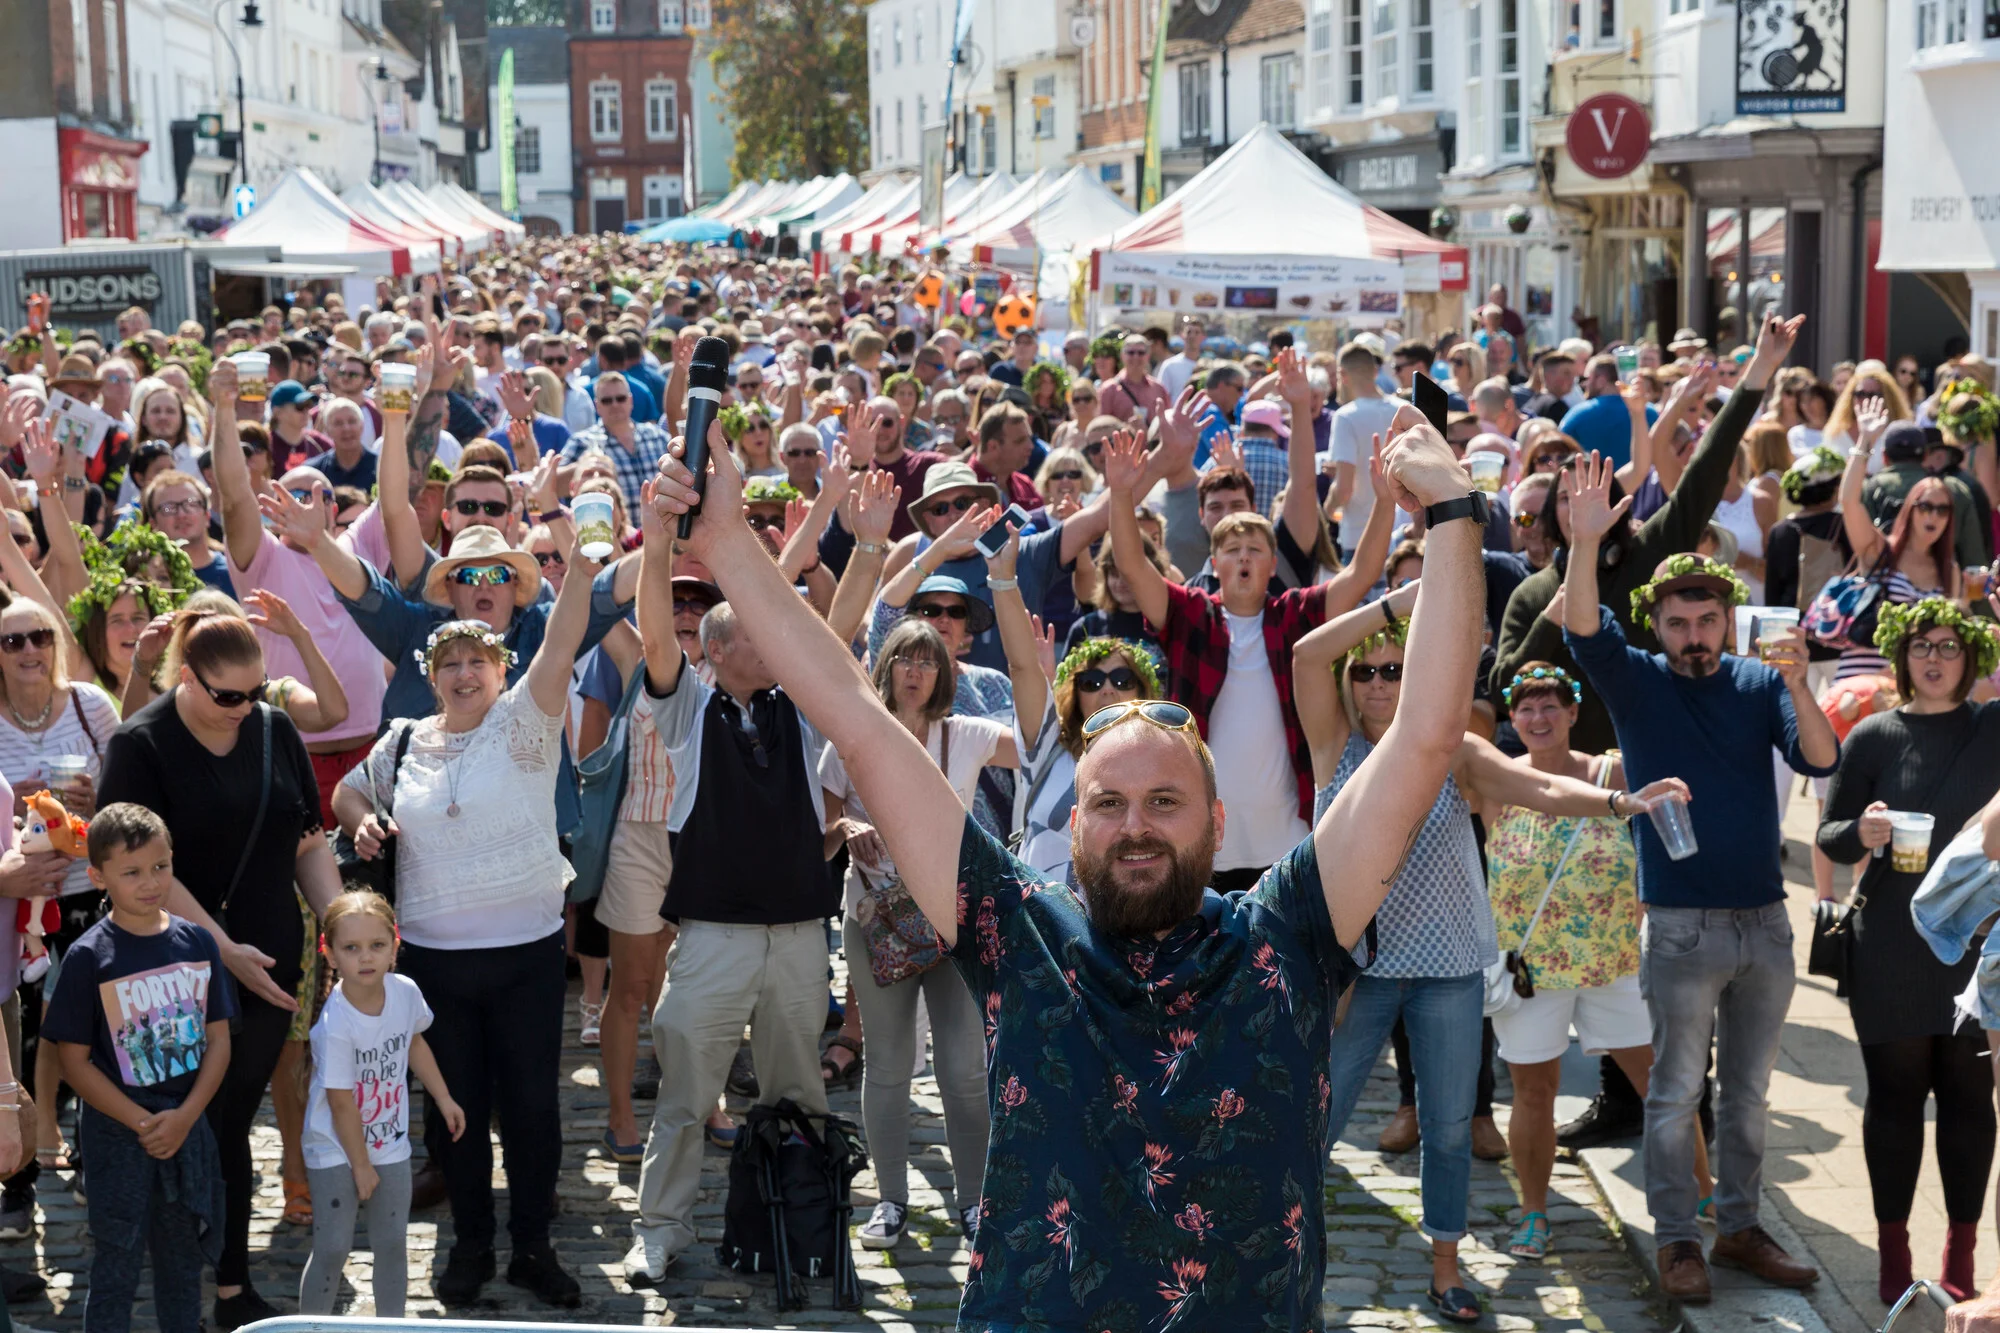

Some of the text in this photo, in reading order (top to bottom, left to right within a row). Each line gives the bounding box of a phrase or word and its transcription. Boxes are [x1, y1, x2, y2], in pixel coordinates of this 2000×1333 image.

[1741, 98, 1839, 111] VISITOR CENTRE
[1590, 108, 1627, 153] V
[1910, 197, 1962, 221] BREWERY
[18, 273, 162, 305] HUDSONS
[355, 1047, 378, 1065] I'm
[380, 1061, 398, 1081] be
